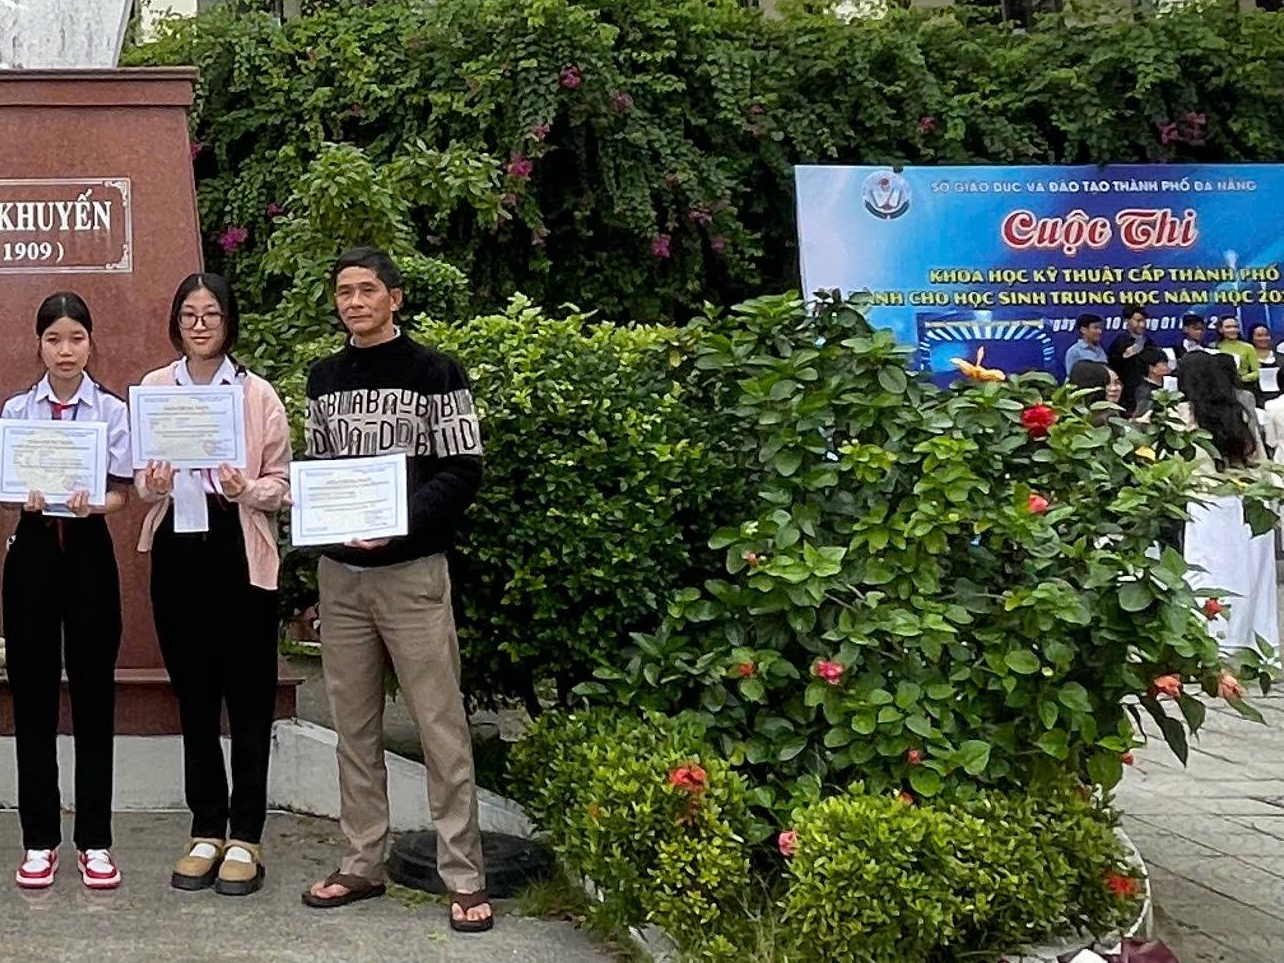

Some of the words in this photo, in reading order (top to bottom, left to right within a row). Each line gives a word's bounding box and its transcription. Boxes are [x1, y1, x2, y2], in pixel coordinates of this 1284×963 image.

[1161, 177, 1190, 192] PHỐ
[1001, 209, 1112, 255] Cuộc
[1116, 208, 1199, 251] Thi
[929, 268, 985, 284] KHOA
[988, 268, 1029, 287] HỌC
[1063, 265, 1124, 286] THUẬT
[1127, 263, 1165, 283] CẤP
[1168, 265, 1235, 283] THÀNH
[1240, 263, 1280, 282] PHỐ
[909, 291, 951, 305] CHO
[954, 291, 995, 309] HỌC
[998, 291, 1047, 305] SINH
[1050, 289, 1116, 305] TRUNG
[1119, 289, 1160, 307] HỌC
[1214, 289, 1255, 307] HỌC
